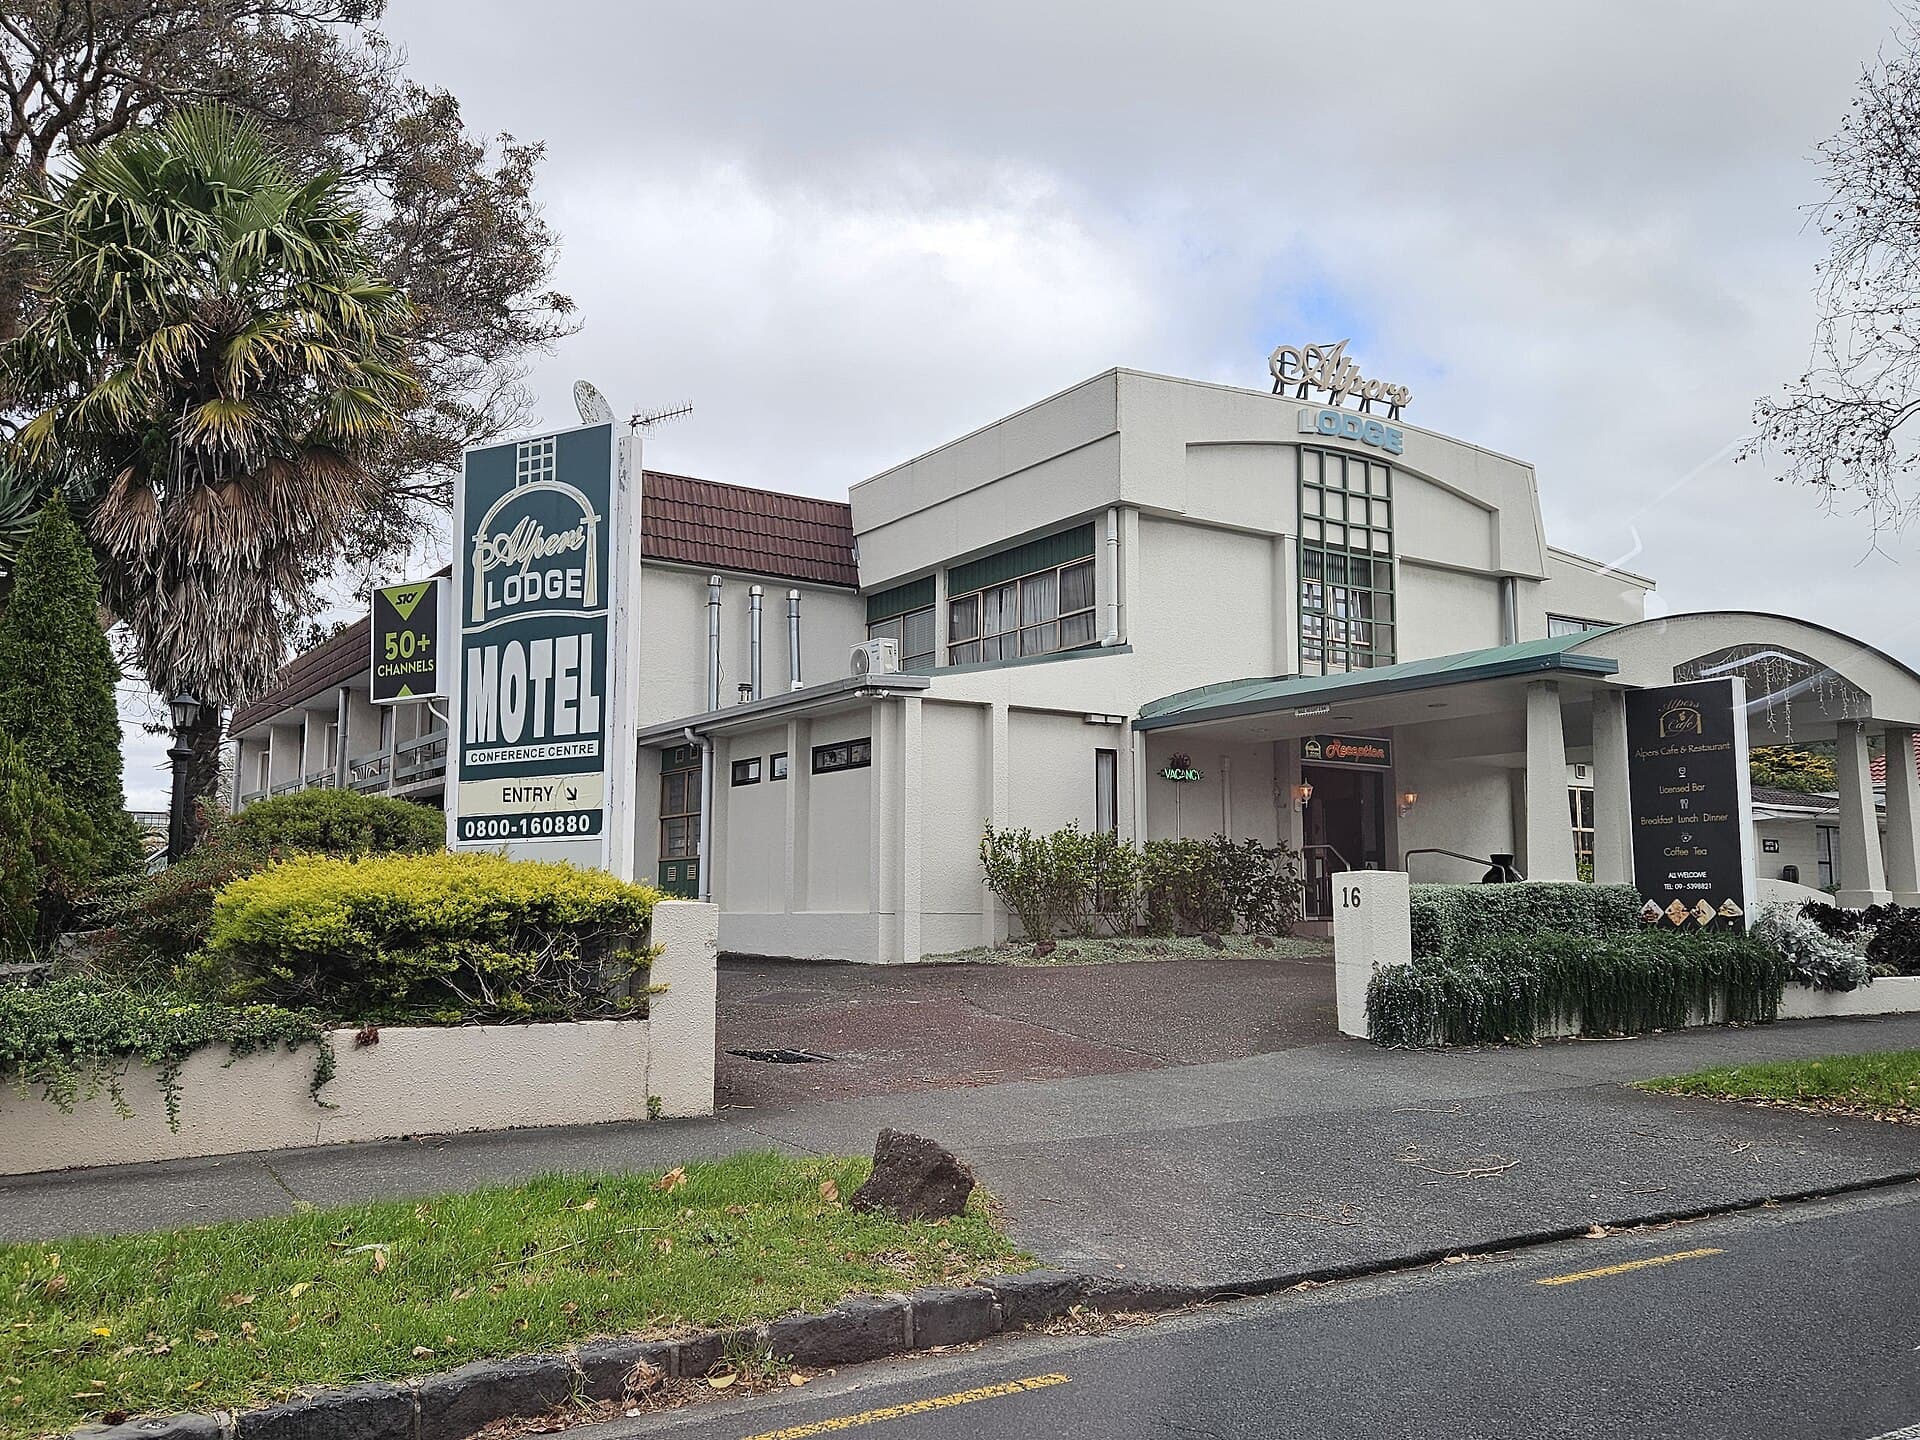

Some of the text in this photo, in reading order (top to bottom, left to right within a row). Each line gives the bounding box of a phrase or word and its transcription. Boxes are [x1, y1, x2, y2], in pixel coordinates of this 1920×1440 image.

[1268, 338, 1413, 405] Alpers
[1298, 409, 1404, 456] LODGE
[472, 515, 586, 578] Alpers
[487, 568, 583, 611] LODGE
[384, 629, 431, 661] 50+
[377, 659, 434, 677] CHANNELS
[465, 633, 600, 744] MOTEL
[470, 743, 595, 763] CONFERENCE CENTRE
[1325, 738, 1385, 762] Reception
[1634, 740, 1731, 761] Alpers Cafe & Restaurant
[1164, 768, 1201, 780] VACANCY
[502, 785, 554, 803] ENTRY
[1659, 782, 1706, 794] Licensed Bar
[464, 814, 591, 838] 0800-160880
[1640, 812, 1729, 826] Breakfast Lunch Dinner
[1663, 846, 1708, 857] Coffee Tea
[1677, 871, 1707, 879] WELCOME
[1342, 886, 1361, 908] 16
